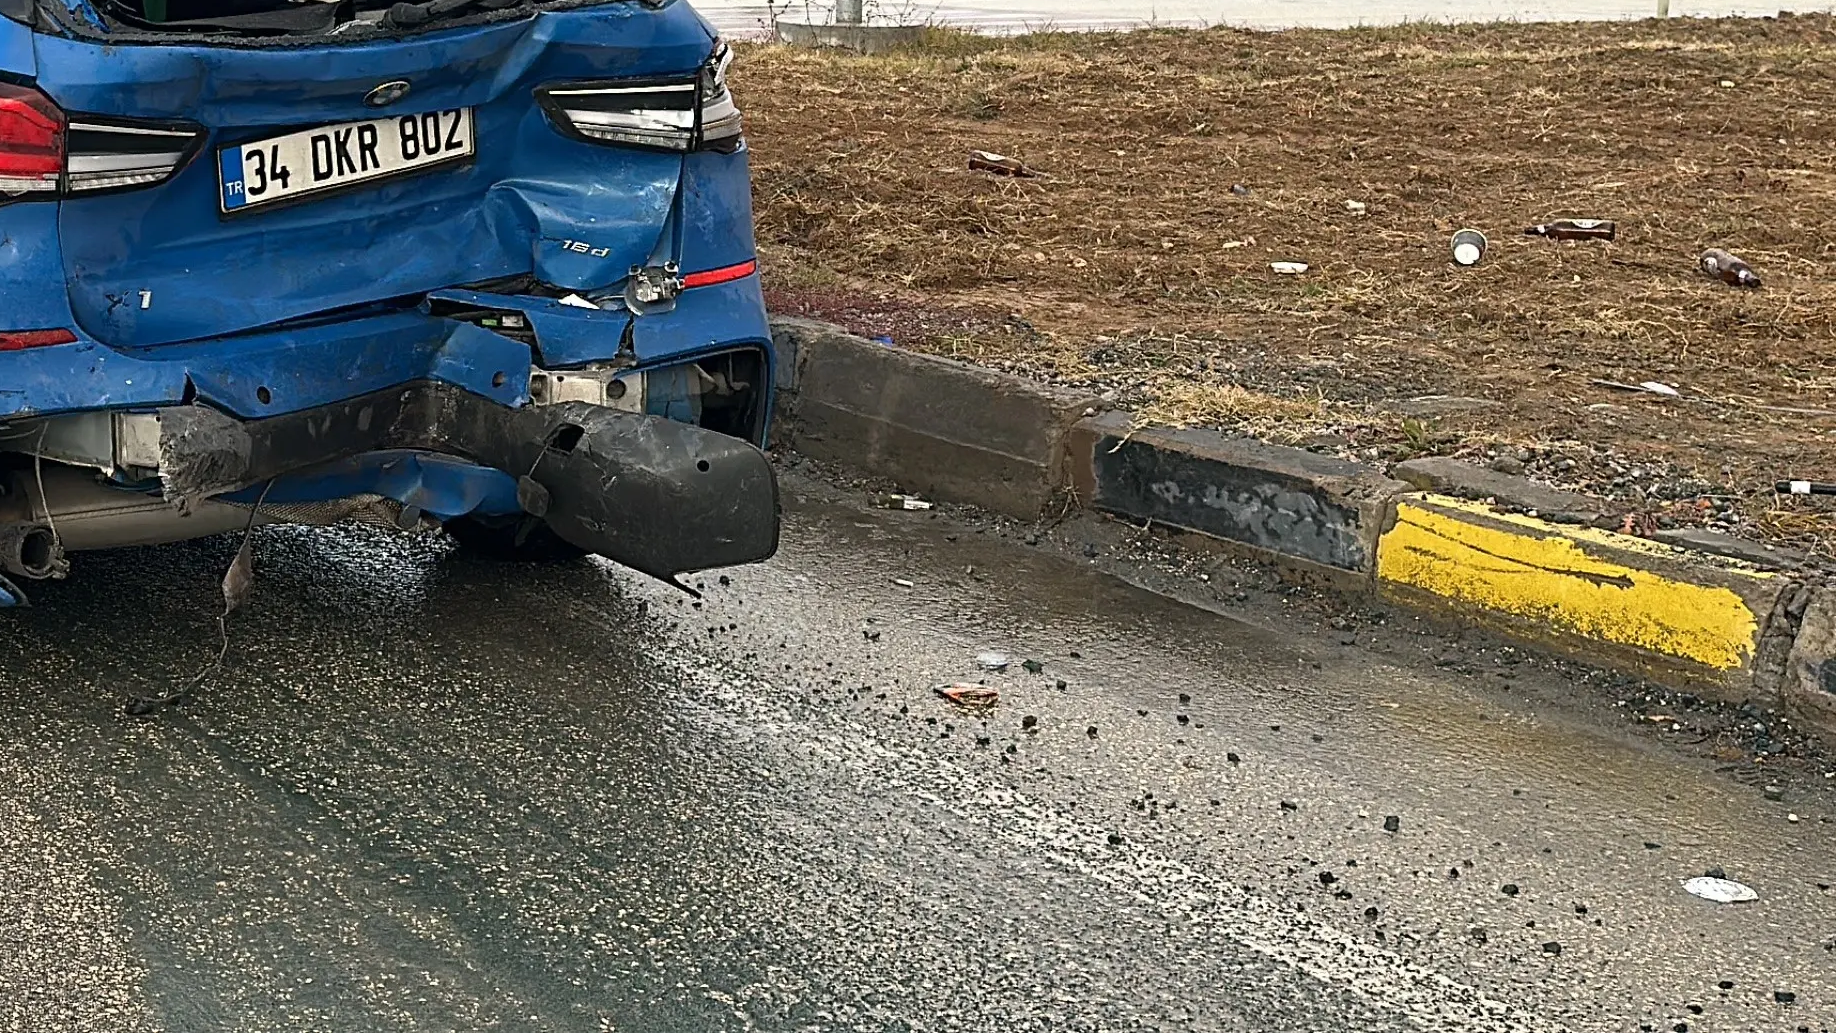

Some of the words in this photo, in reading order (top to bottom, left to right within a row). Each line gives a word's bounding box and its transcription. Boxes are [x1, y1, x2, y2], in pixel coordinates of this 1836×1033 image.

[225, 180, 244, 196] TR
[245, 145, 291, 196] 34
[311, 123, 381, 182] DKR
[399, 109, 464, 160] 802
